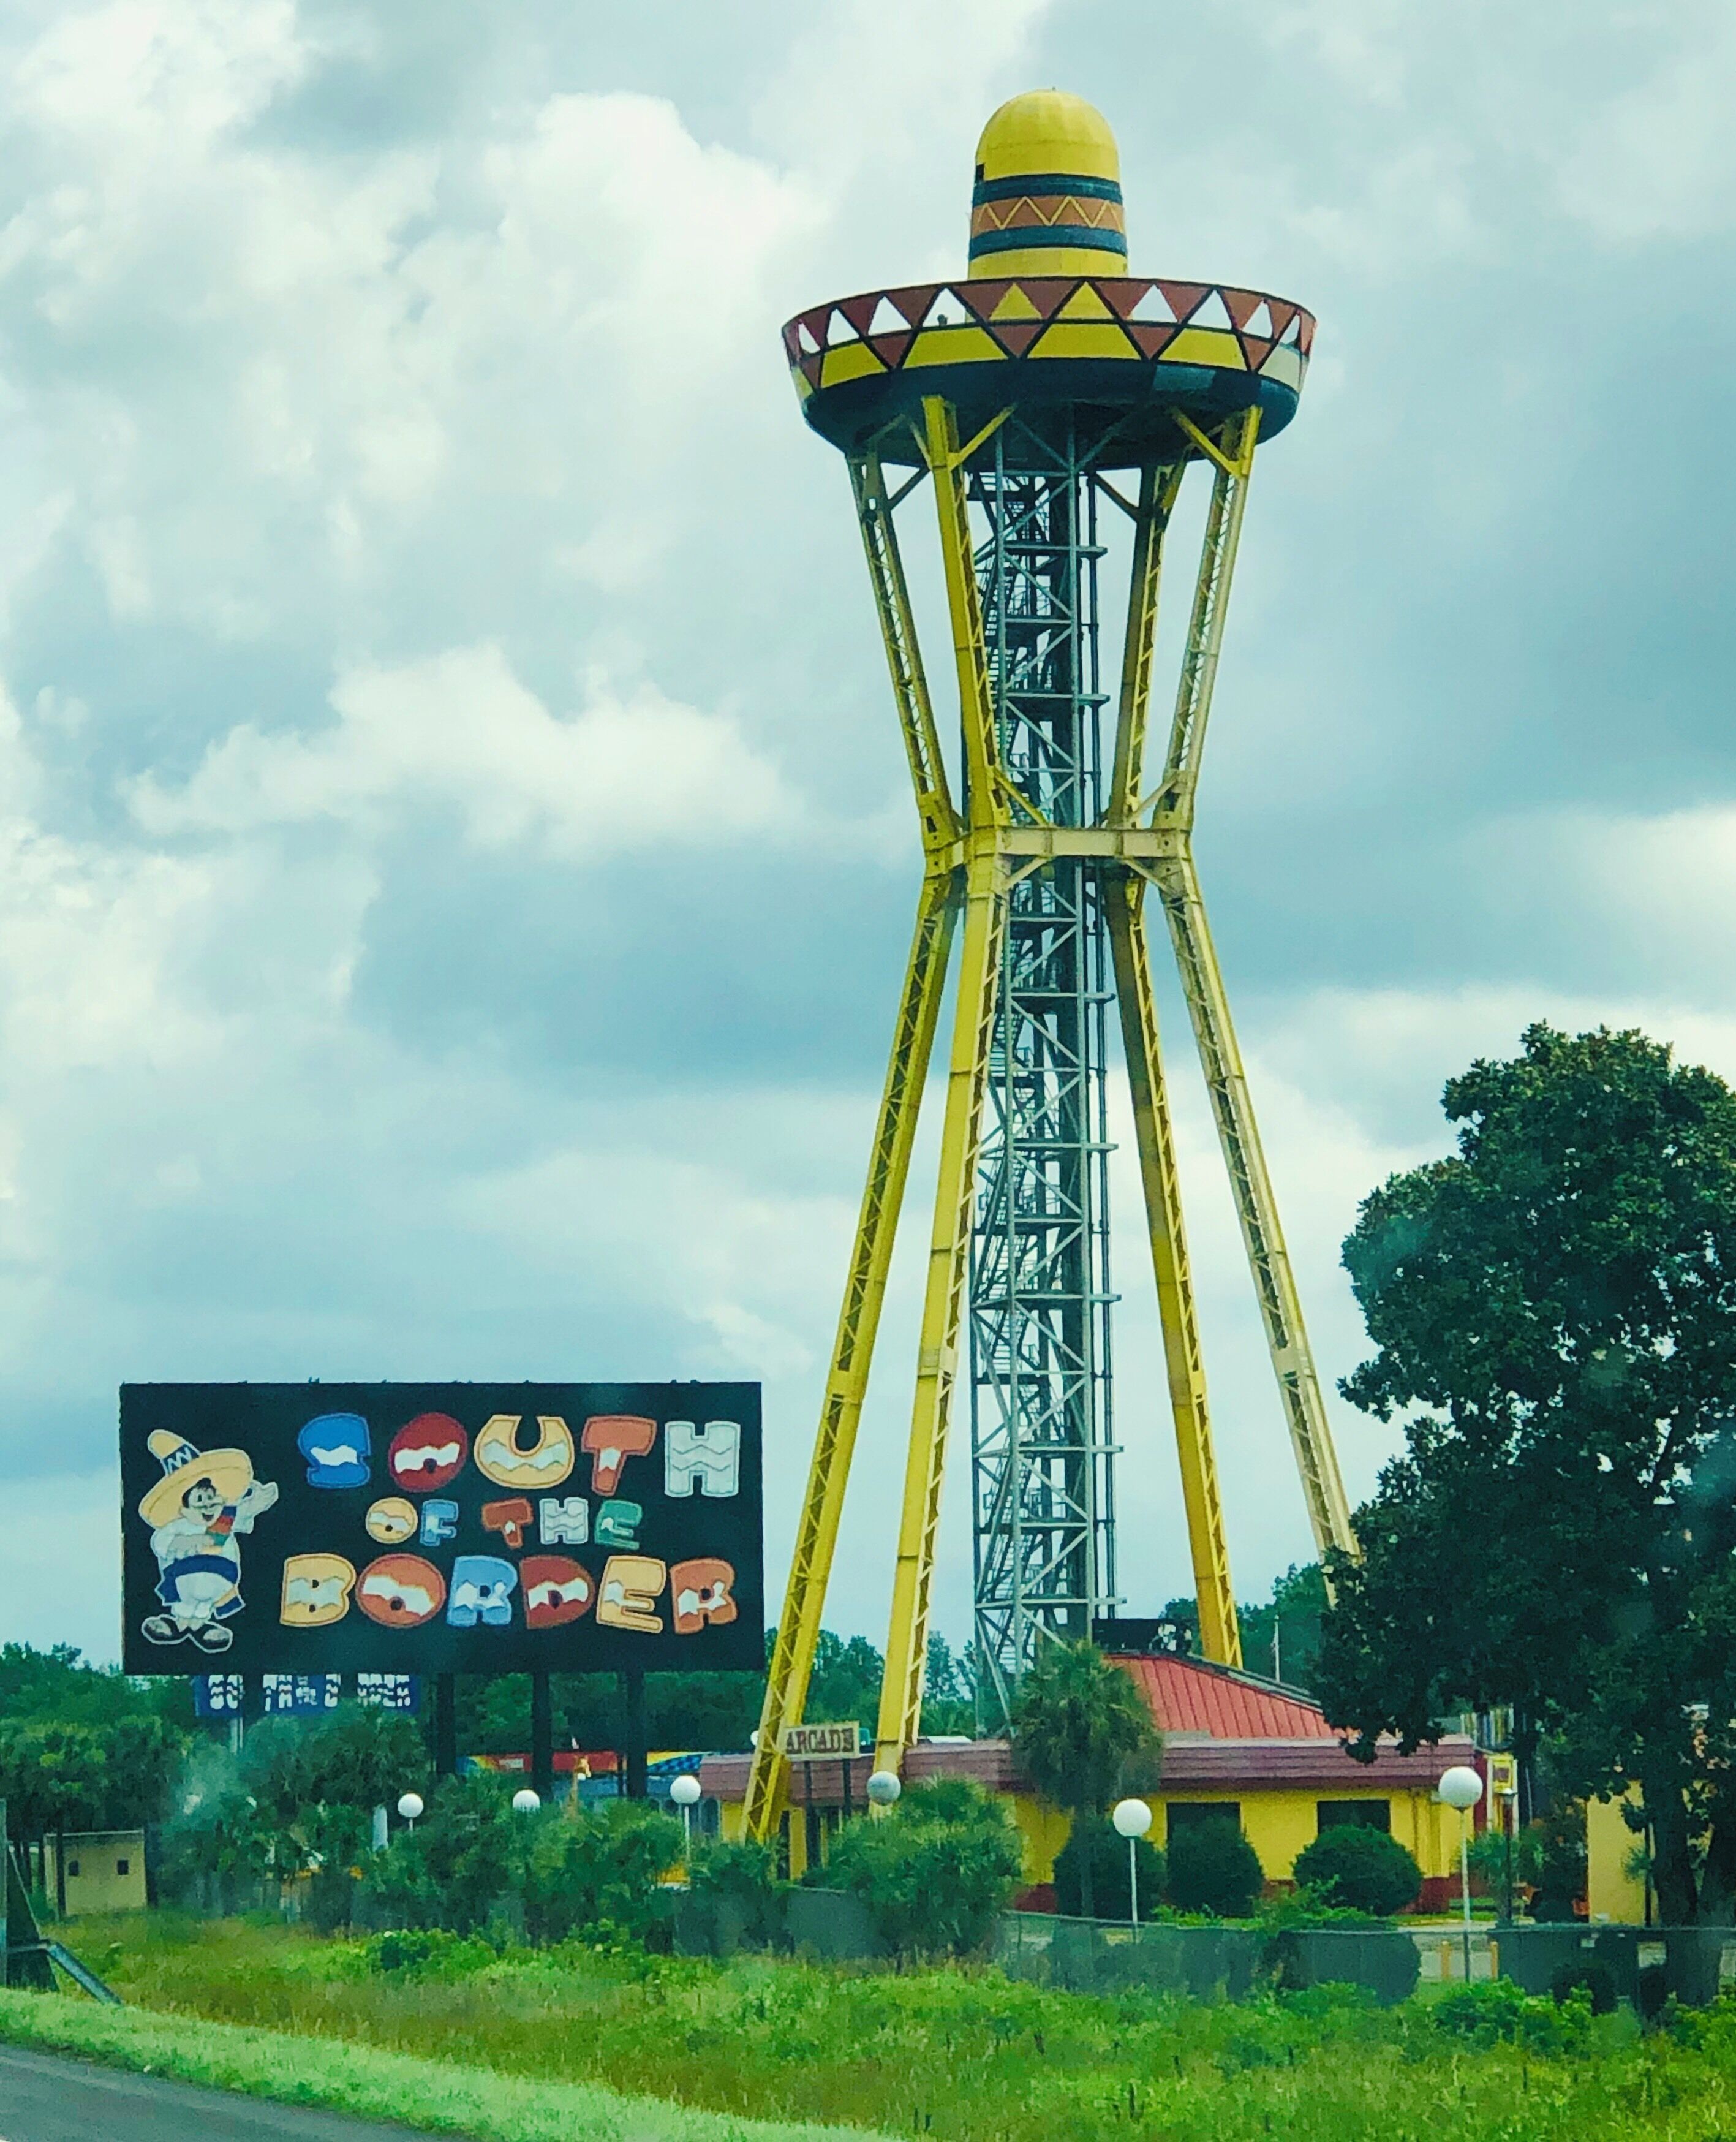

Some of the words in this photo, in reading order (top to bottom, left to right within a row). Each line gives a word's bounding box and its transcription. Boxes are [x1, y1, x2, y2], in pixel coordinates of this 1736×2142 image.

[297, 1412, 741, 1497] SOUTH
[366, 1497, 459, 1546] OF
[481, 1497, 643, 1549] THE
[280, 1553, 738, 1635] BORDER
[786, 1727, 854, 1754] ARCADE
